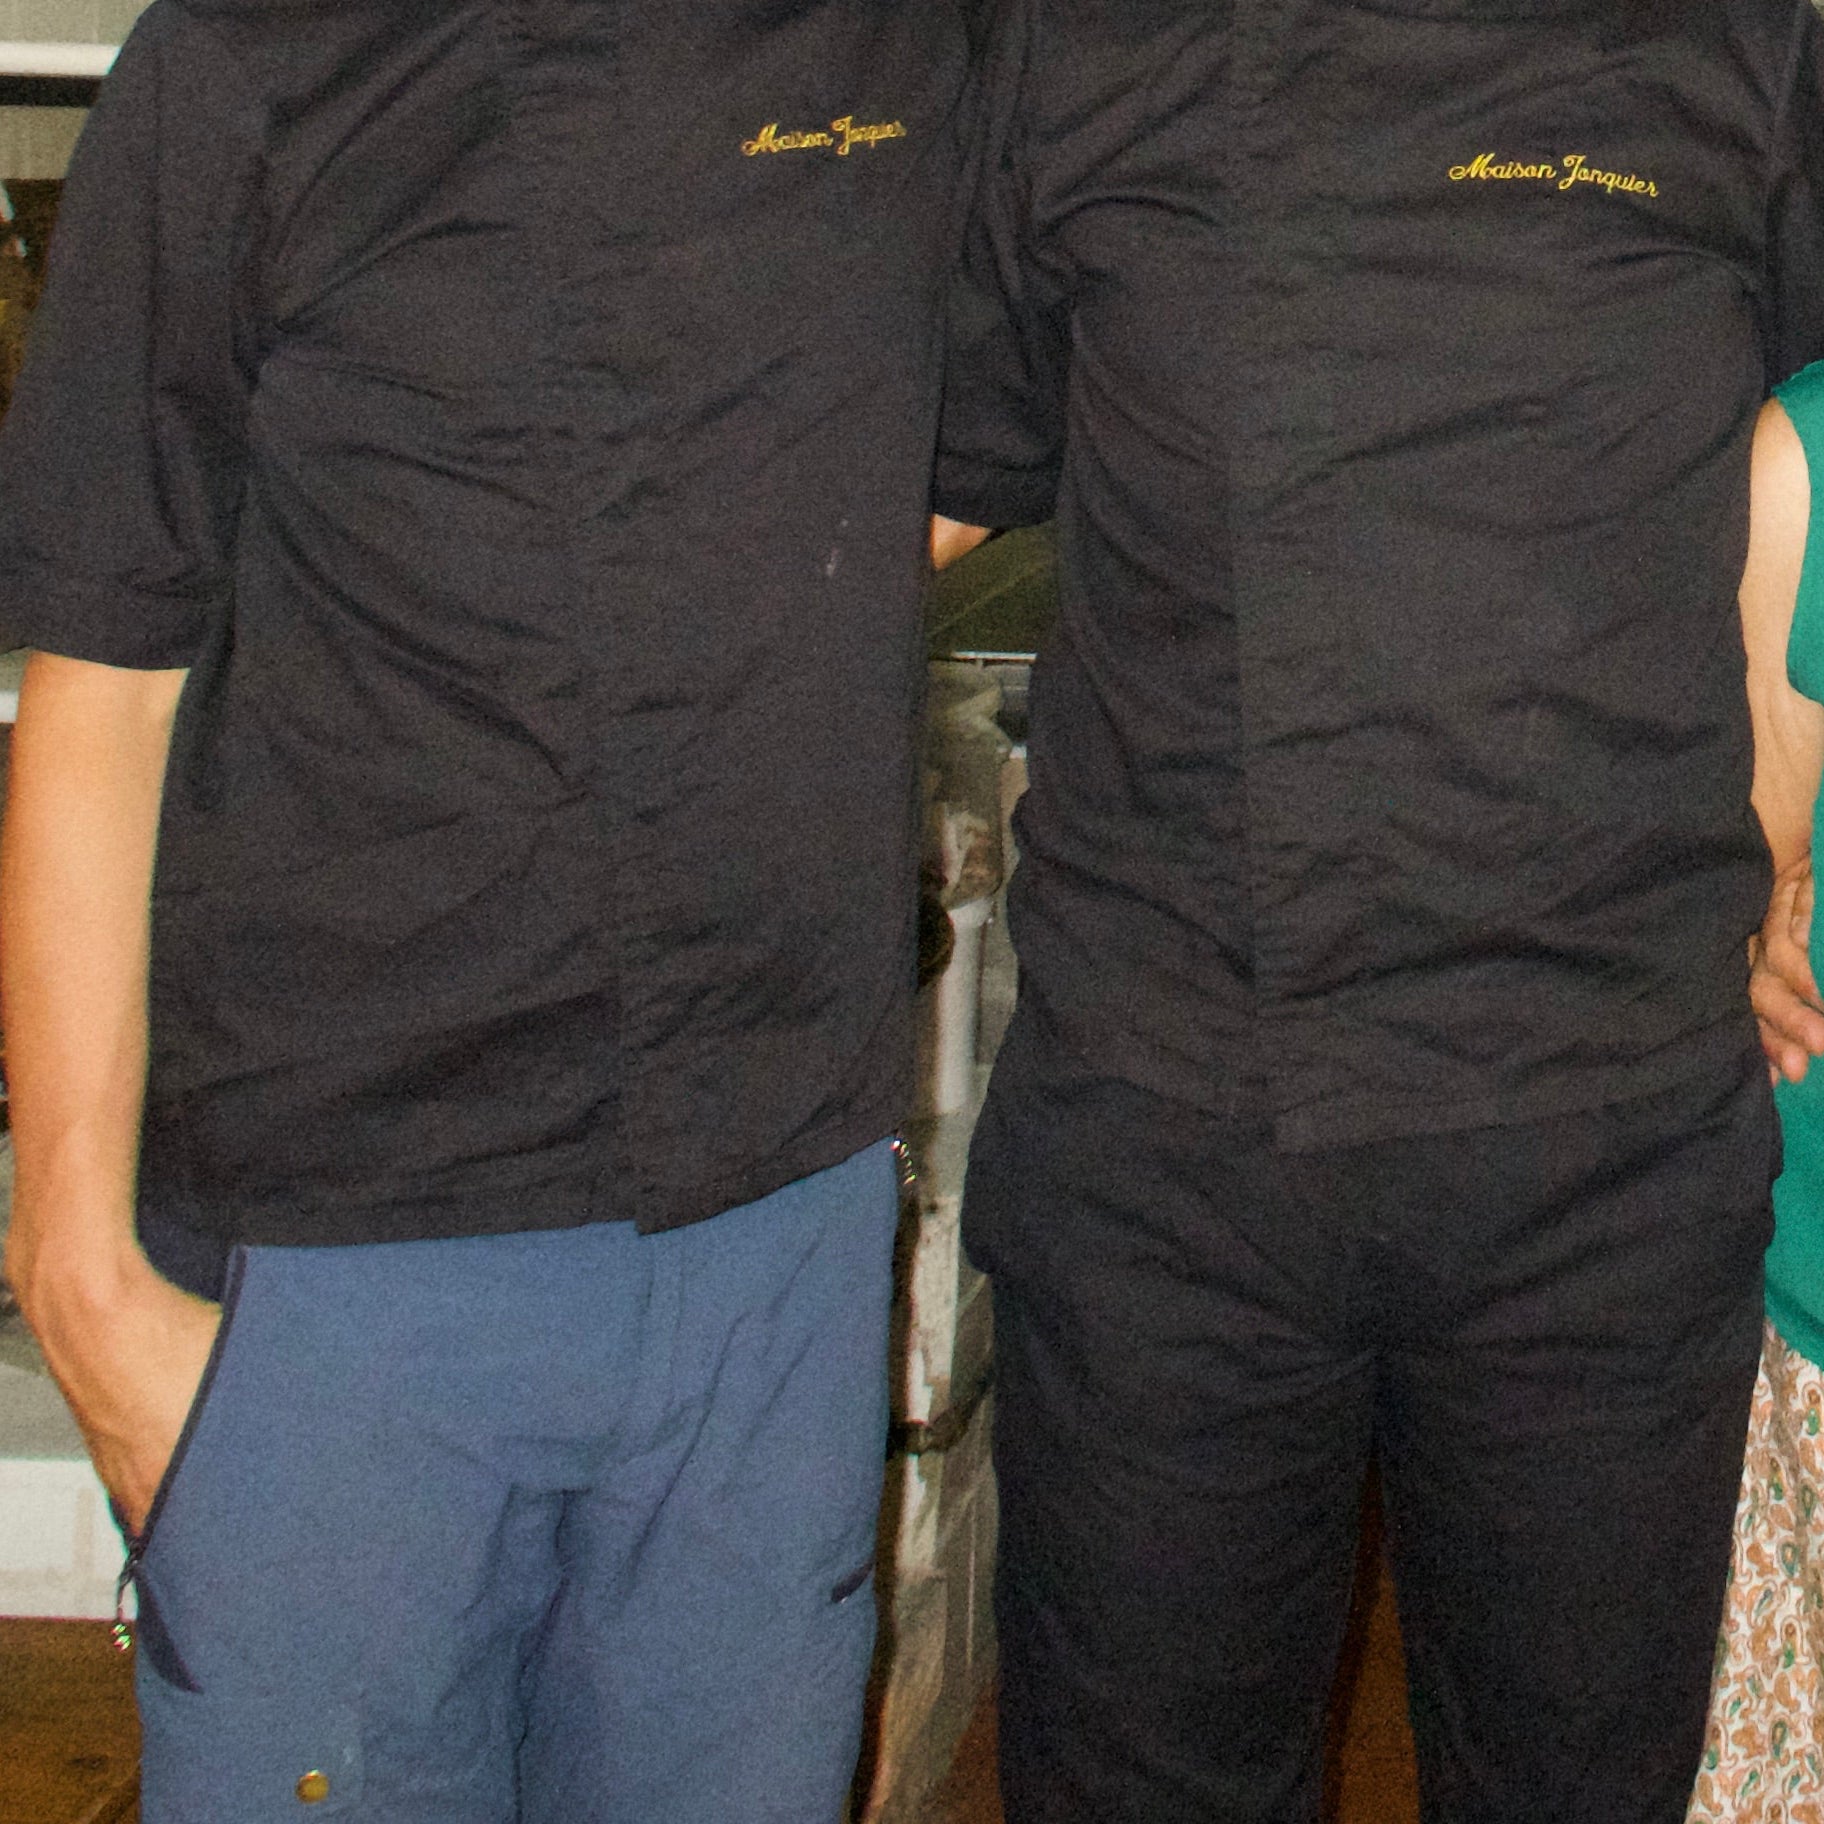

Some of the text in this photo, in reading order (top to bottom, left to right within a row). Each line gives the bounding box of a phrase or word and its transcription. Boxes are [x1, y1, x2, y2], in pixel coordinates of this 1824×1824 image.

[740, 122, 834, 156] Maison
[1448, 152, 1660, 198] Maison Jonquier
